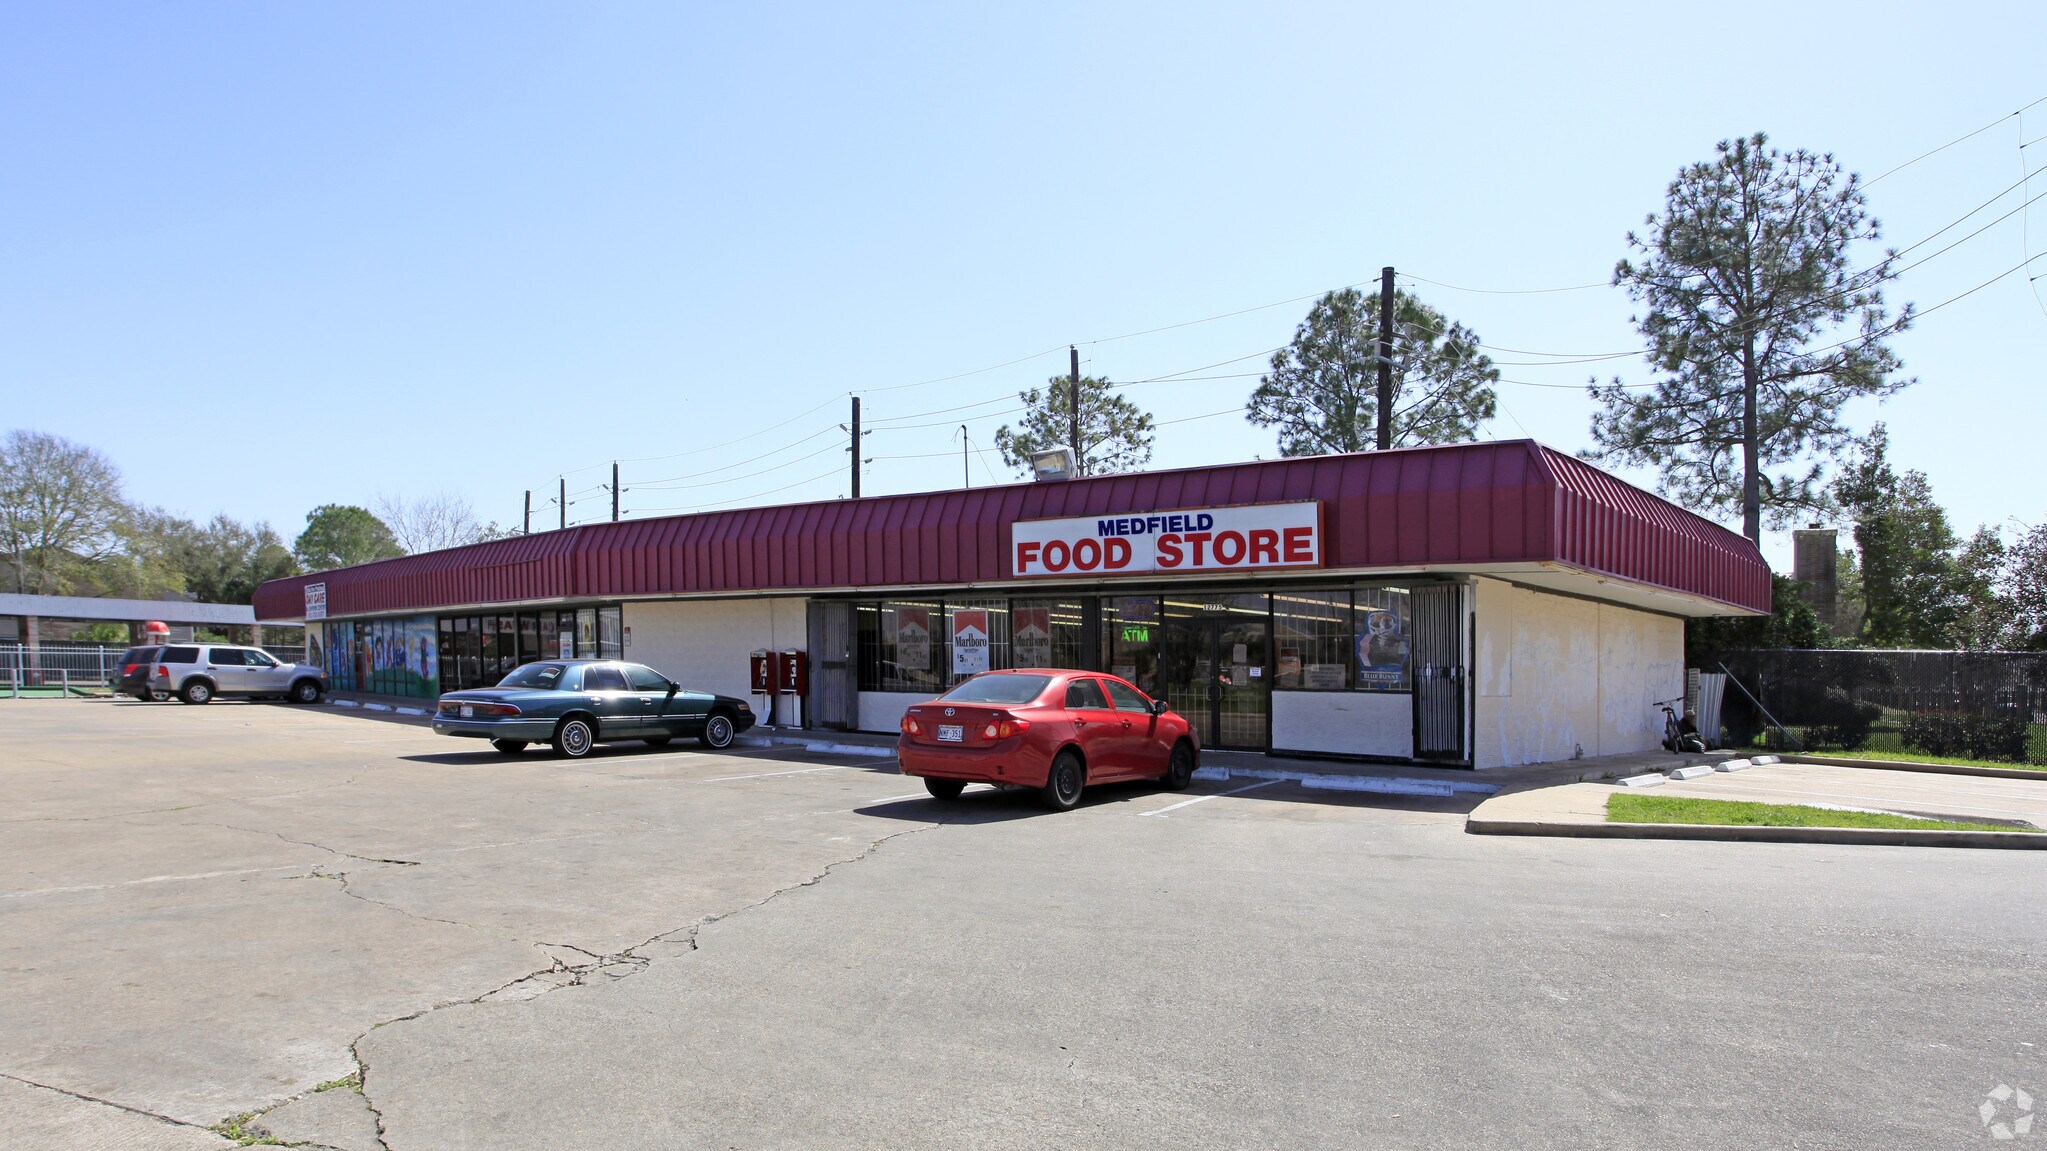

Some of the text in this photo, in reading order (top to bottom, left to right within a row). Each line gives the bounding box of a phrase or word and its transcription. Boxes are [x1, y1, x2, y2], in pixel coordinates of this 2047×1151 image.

[1097, 513, 1214, 537] MEDFIELD
[1017, 526, 1314, 573] FOOD STORE
[899, 629, 928, 643] Marlboro
[955, 632, 987, 647] Marlboro
[1014, 631, 1049, 647] Marlboro
[1121, 629, 1149, 642] ATM
